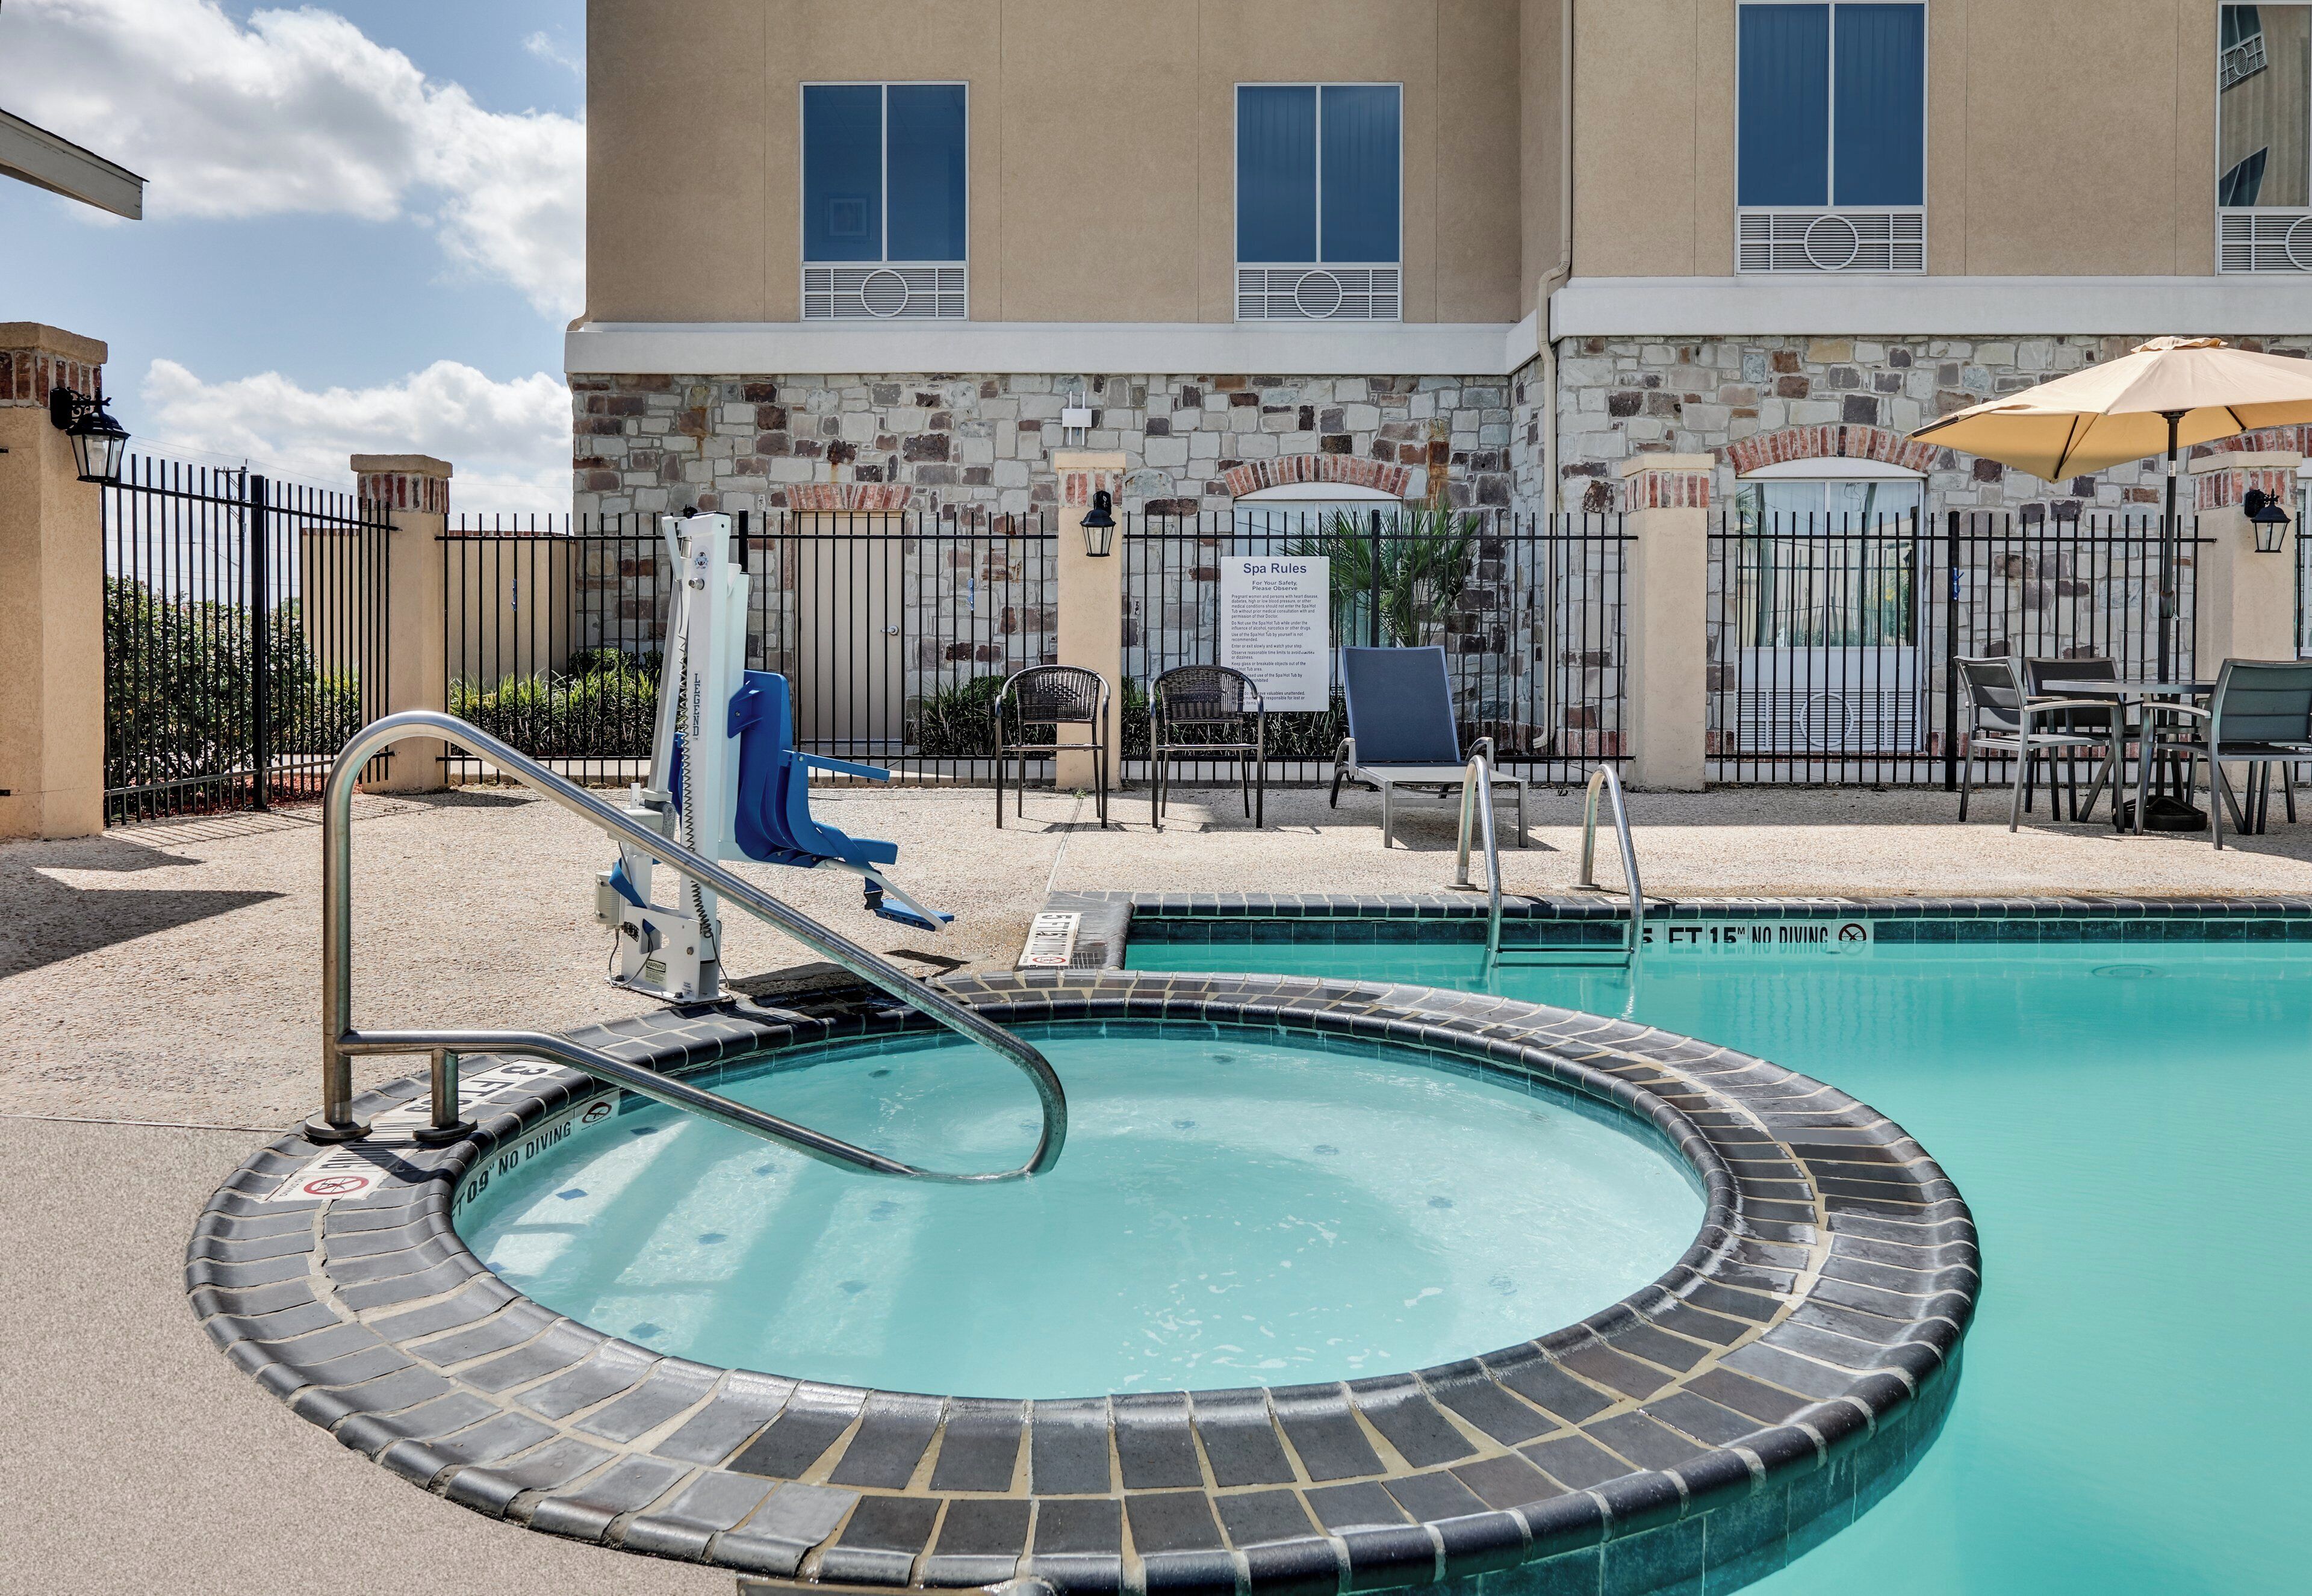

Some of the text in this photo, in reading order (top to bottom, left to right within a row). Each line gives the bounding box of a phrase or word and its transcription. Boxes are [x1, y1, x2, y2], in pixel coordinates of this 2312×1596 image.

[1243, 563, 1307, 576] Spa Rules
[1669, 927, 1703, 943] FT
[1752, 926, 1771, 943] NO
[1779, 926, 1828, 943] DIVING
[647, 961, 665, 970] WARNING
[499, 1150, 518, 1177] NO
[526, 1121, 571, 1161] DIVING
